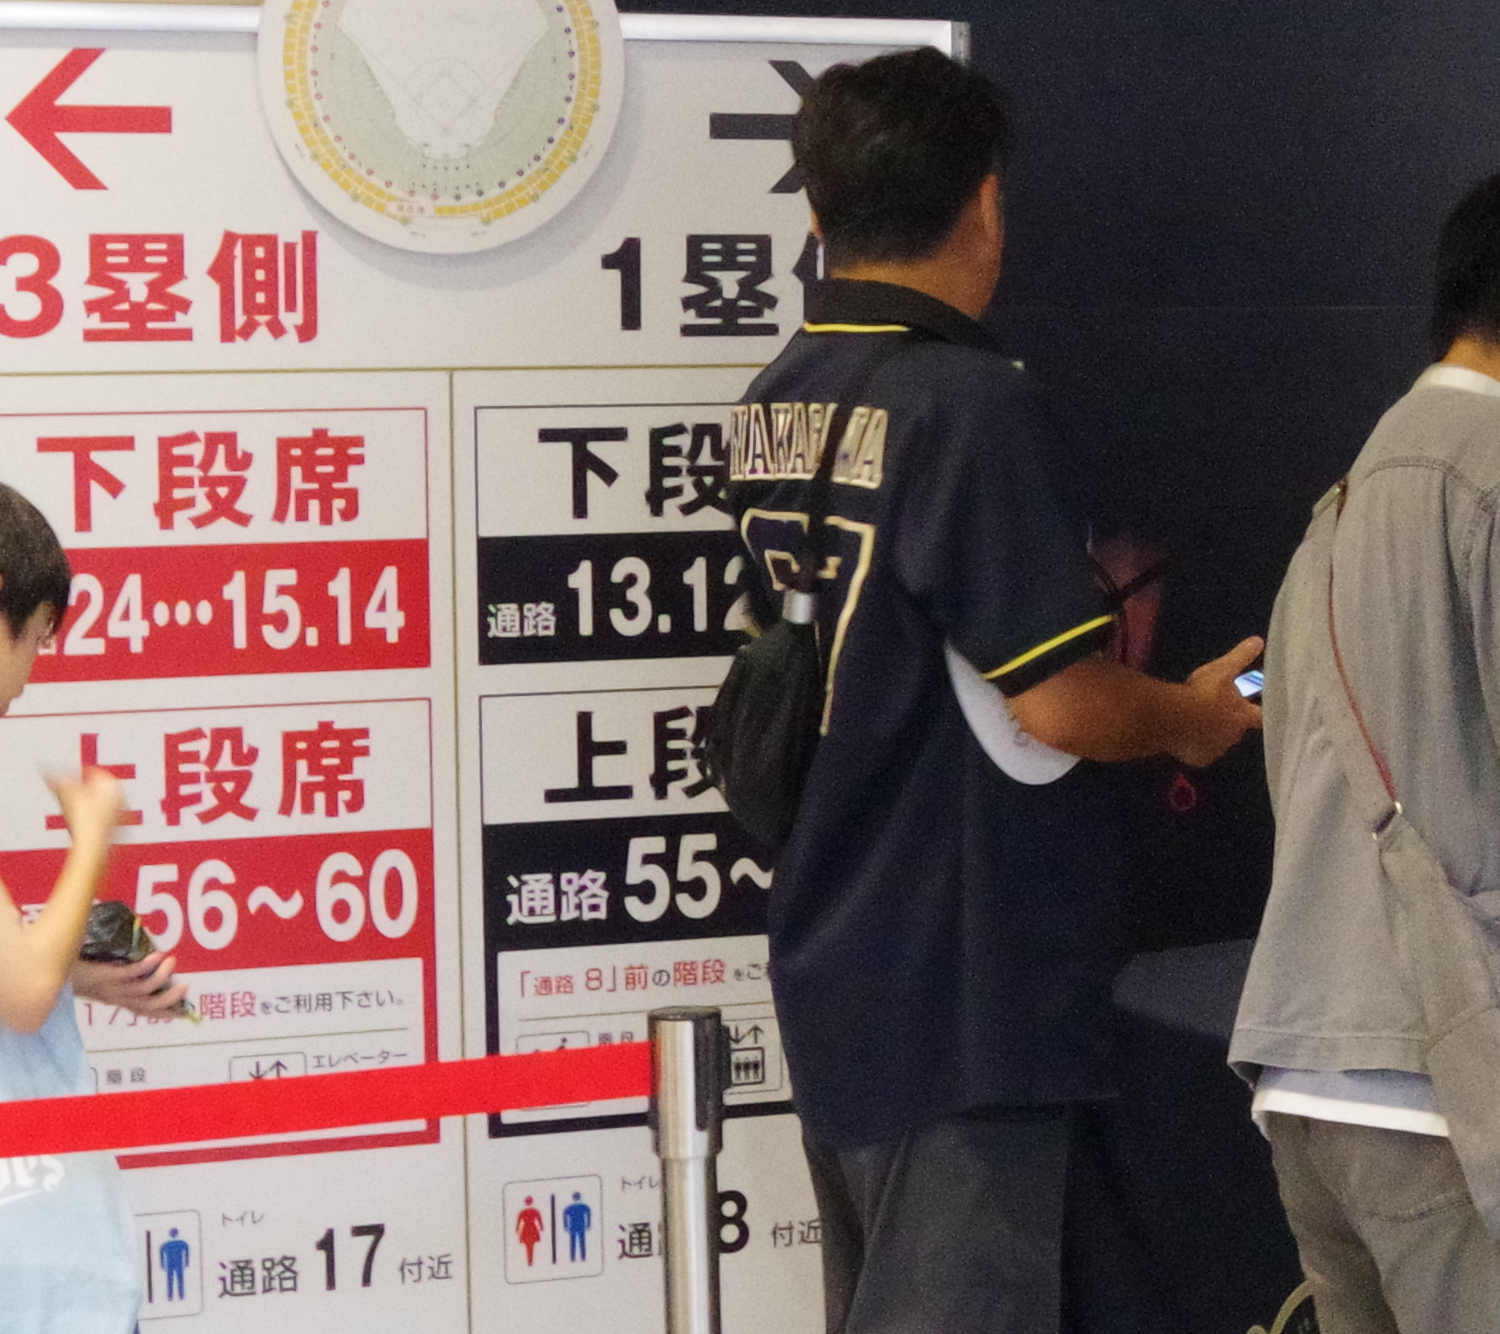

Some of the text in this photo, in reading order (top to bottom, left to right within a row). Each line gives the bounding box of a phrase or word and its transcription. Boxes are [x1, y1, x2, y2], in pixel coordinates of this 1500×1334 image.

[601, 234, 823, 338] 1塁
[37, 429, 366, 534] 下段席
[312, 1049, 408, 1069] エレベーター
[220, 1210, 265, 1227] トイレ
[617, 1222, 665, 1260] 通
[218, 1223, 454, 1299] 通路 17 付近
